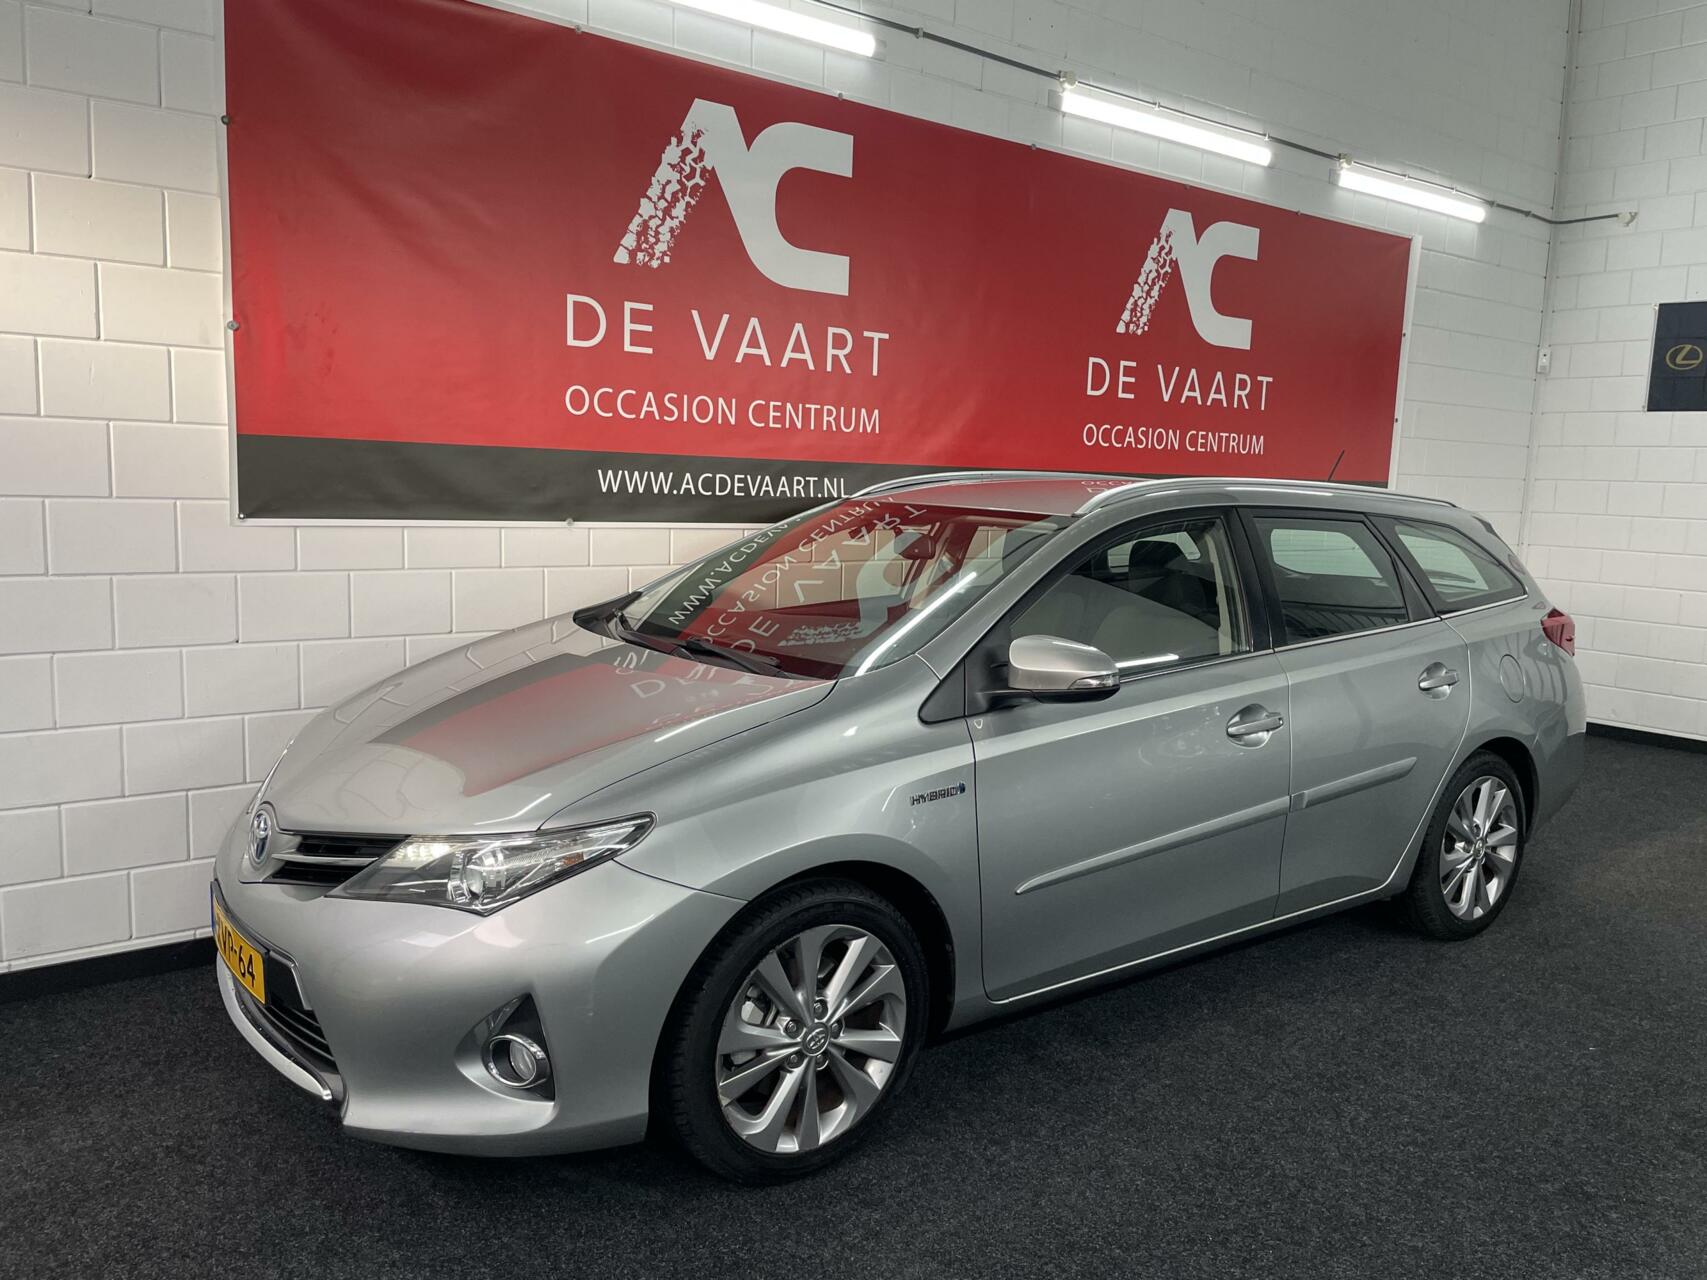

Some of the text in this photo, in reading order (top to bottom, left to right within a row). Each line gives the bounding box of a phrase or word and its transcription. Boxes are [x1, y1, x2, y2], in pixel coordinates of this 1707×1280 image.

[566, 293, 890, 377] DE VAART
[1086, 356, 1273, 411] DE VAART
[565, 384, 881, 434] OCCASION CENTRUM
[1082, 423, 1264, 455] OCCASION CENTRUM
[597, 468, 851, 499] WWW.ACDEVAART.NL
[911, 786, 958, 806] HYBRID
